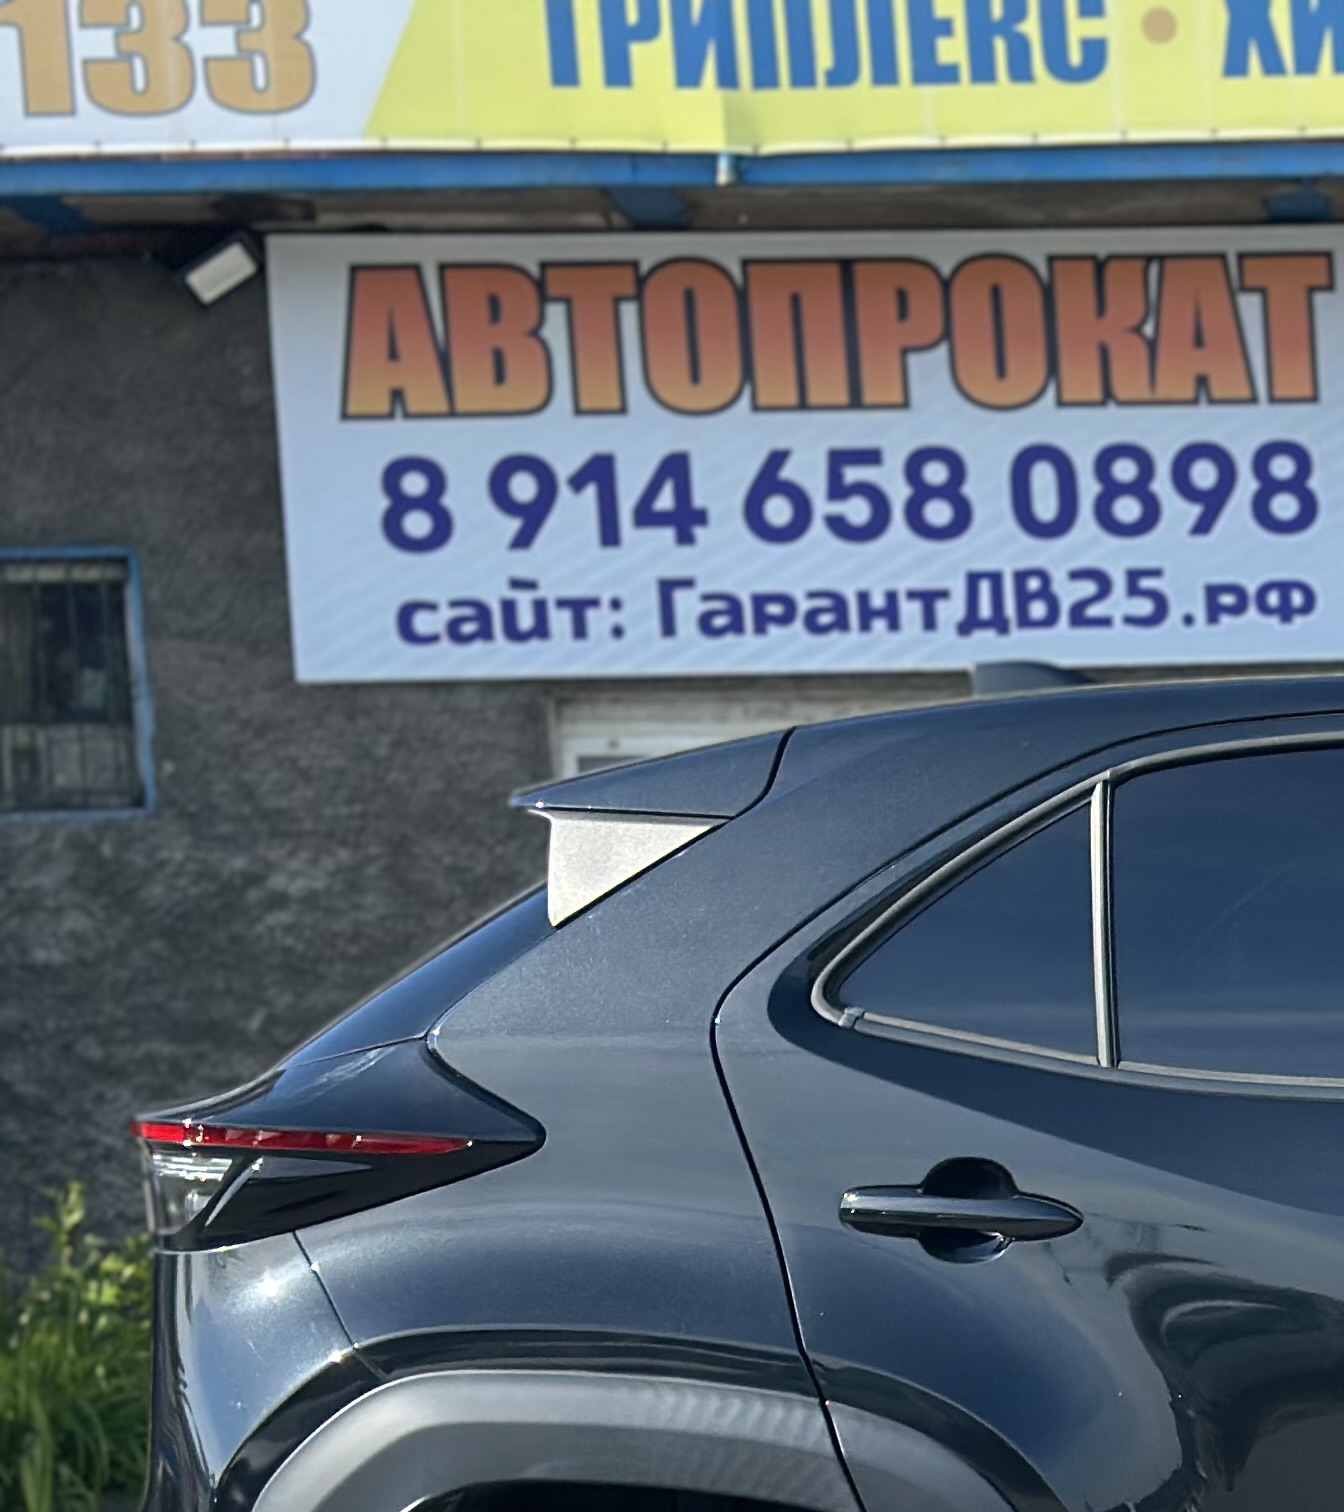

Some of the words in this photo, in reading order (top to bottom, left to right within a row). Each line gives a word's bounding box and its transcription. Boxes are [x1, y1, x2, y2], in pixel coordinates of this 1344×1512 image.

[340, 251, 1335, 421] АВТОПРОКАТ
[379, 456, 454, 554] 8
[486, 451, 709, 551] 914
[741, 446, 974, 545] 658
[1008, 441, 1321, 540] 0898
[395, 578, 627, 646] сайт:
